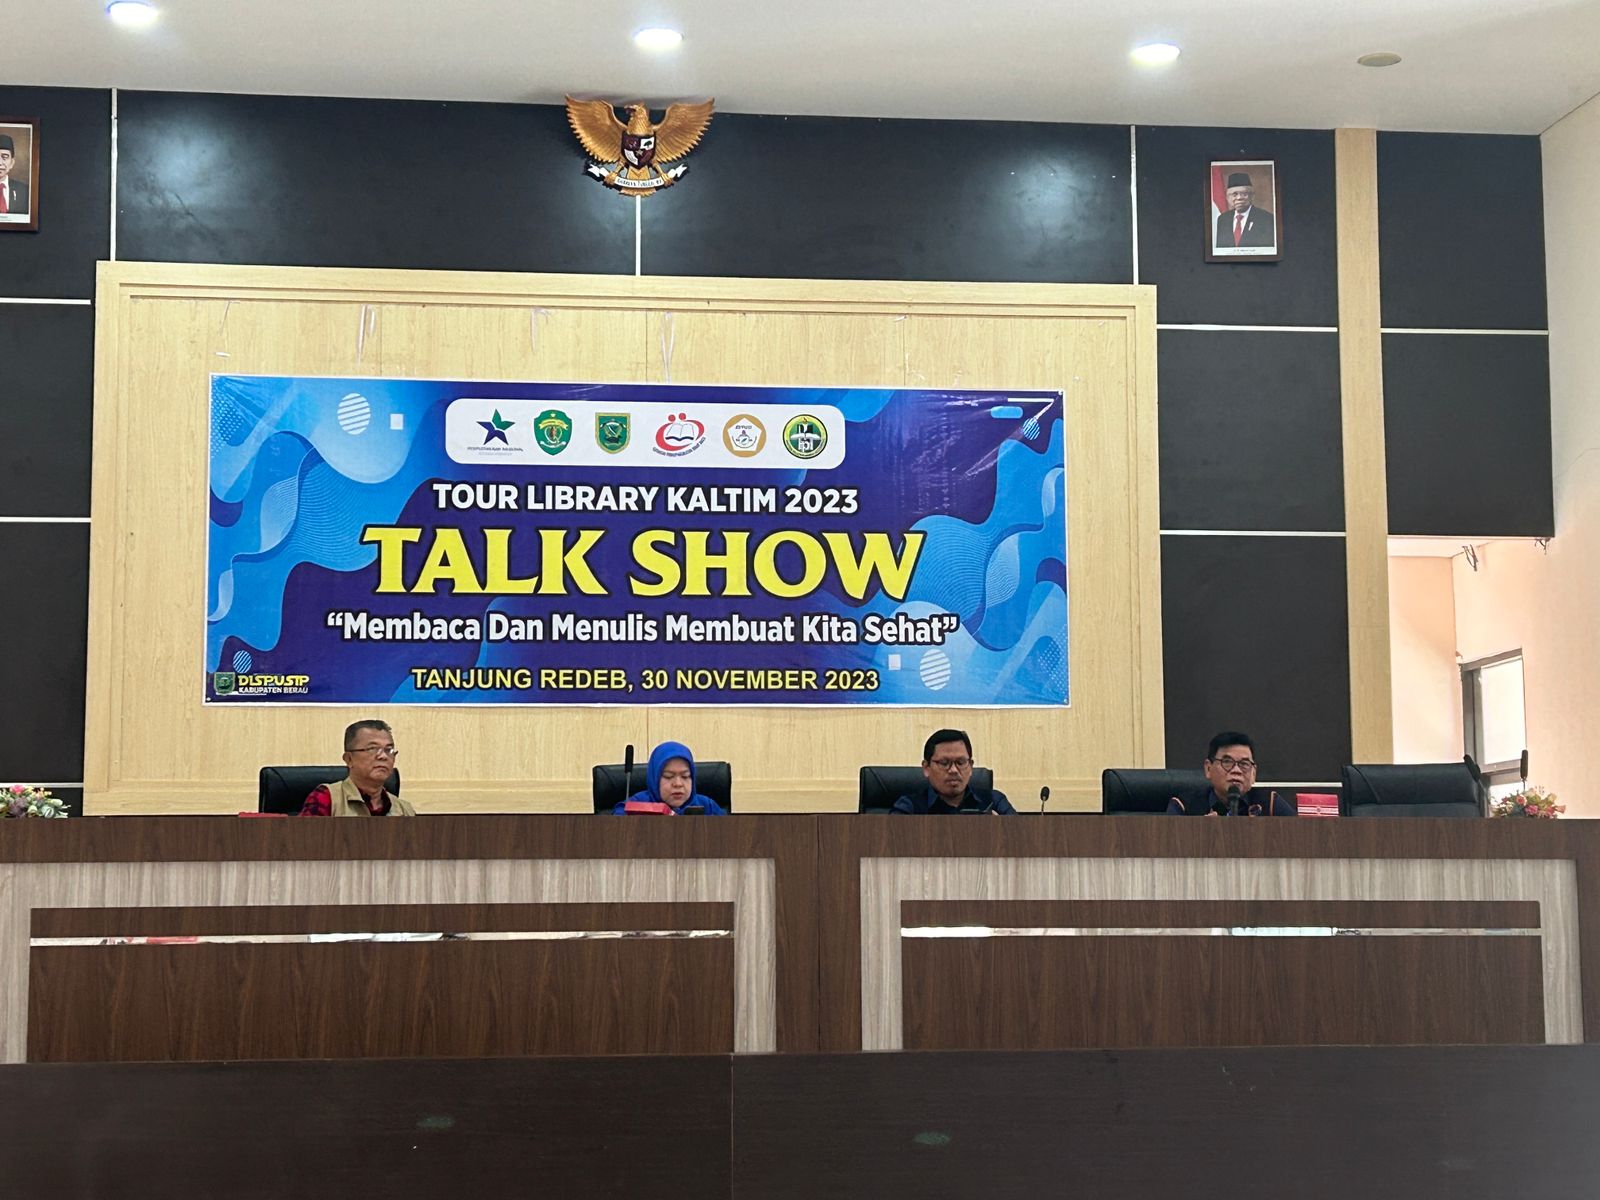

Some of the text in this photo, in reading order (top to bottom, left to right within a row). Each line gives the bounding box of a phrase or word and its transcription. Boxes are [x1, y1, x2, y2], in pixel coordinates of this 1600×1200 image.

[432, 483, 859, 513] TOUR LIBRARY KALTIM 2023
[362, 527, 924, 600] TALK SHOW
[327, 612, 957, 643] “Membaca Dan Menulis Membuat Kita Sehat”
[411, 668, 879, 693] TANJUNG REDEB, 30 NOVEMBER 2023
